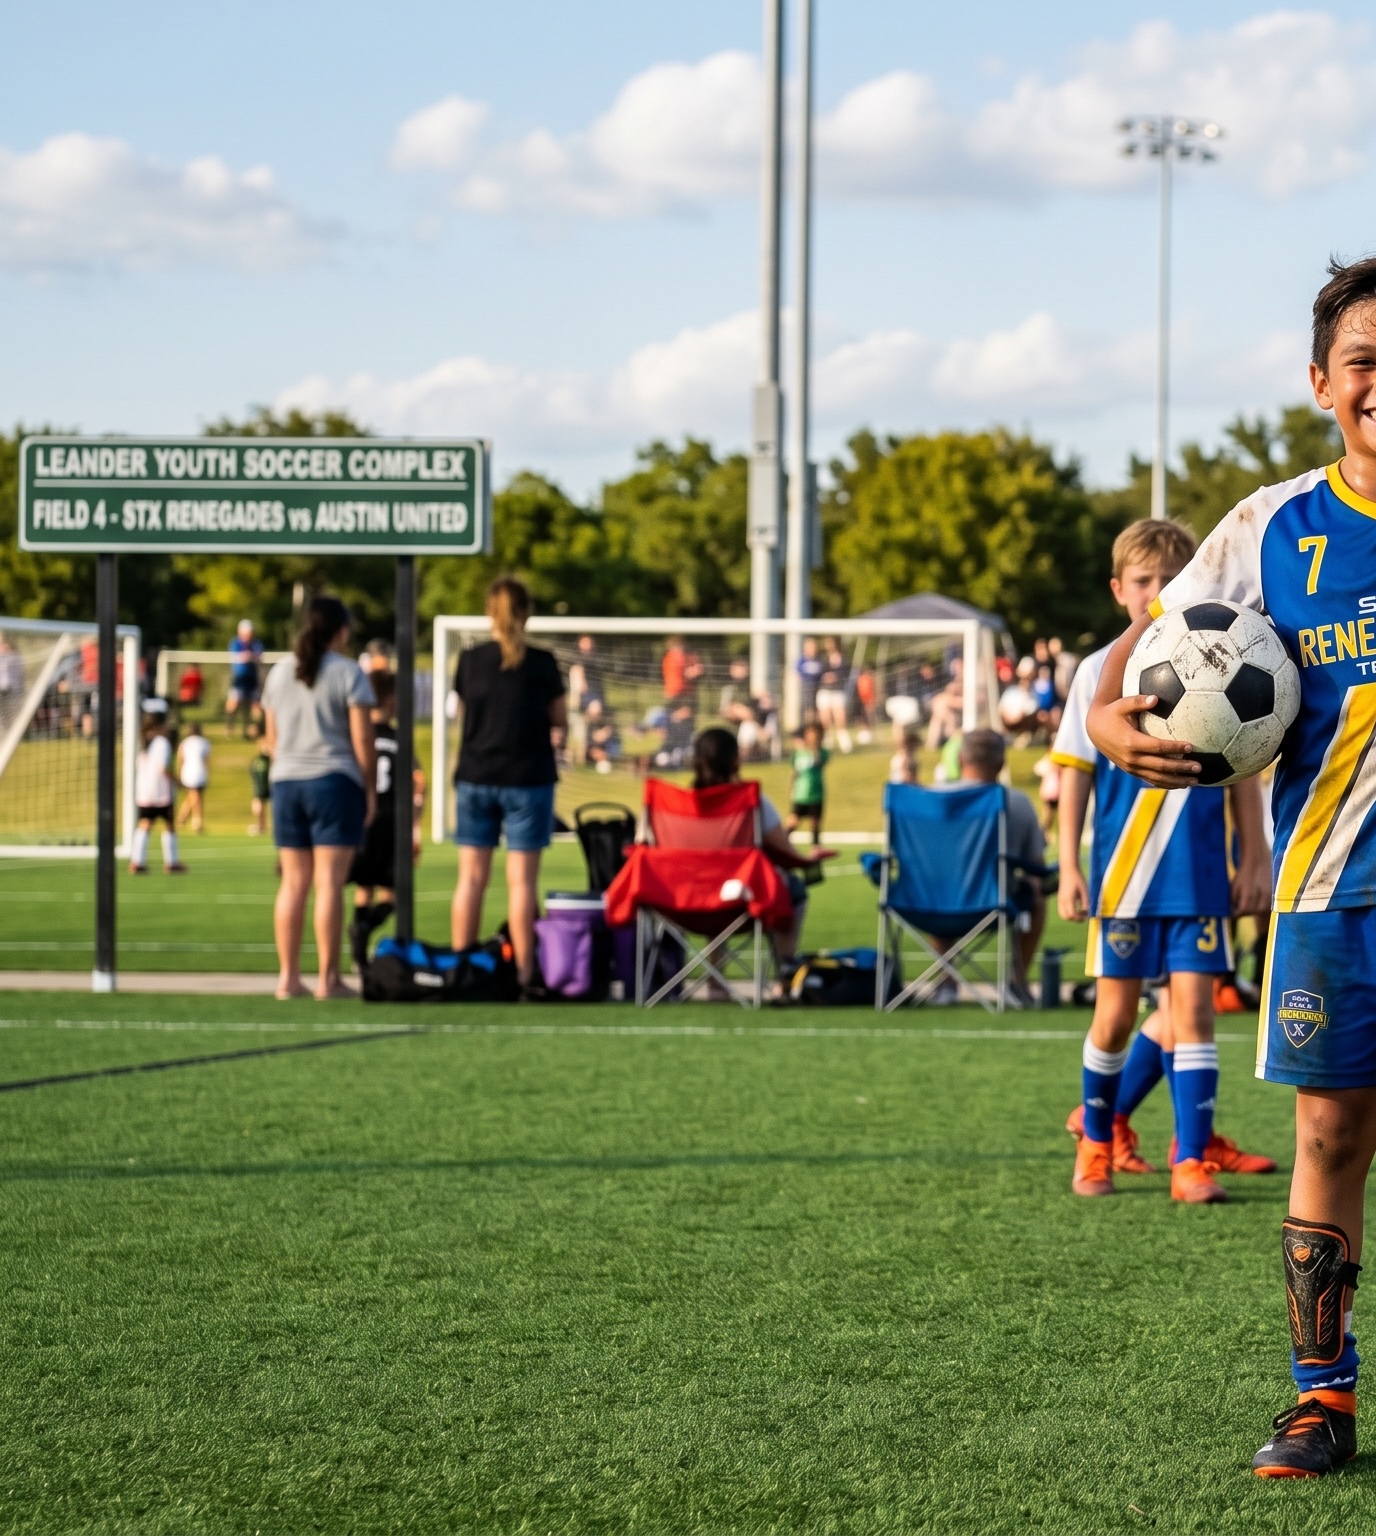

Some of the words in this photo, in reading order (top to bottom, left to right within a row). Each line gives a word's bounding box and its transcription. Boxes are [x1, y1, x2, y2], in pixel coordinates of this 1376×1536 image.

[35, 447, 148, 478] LEANDER
[153, 448, 237, 479] YOUTH
[243, 448, 343, 480] SOCCER
[348, 449, 467, 480] COMPLEX
[33, 499, 90, 531] FIELD
[93, 499, 107, 531] 4
[122, 499, 163, 531] STX
[165, 500, 285, 532] RENEGADES
[287, 507, 312, 532] vs
[315, 501, 390, 533] AUSTIN
[392, 502, 469, 533] UNITED
[1298, 535, 1328, 596] 7
[1197, 917, 1218, 953] 3
